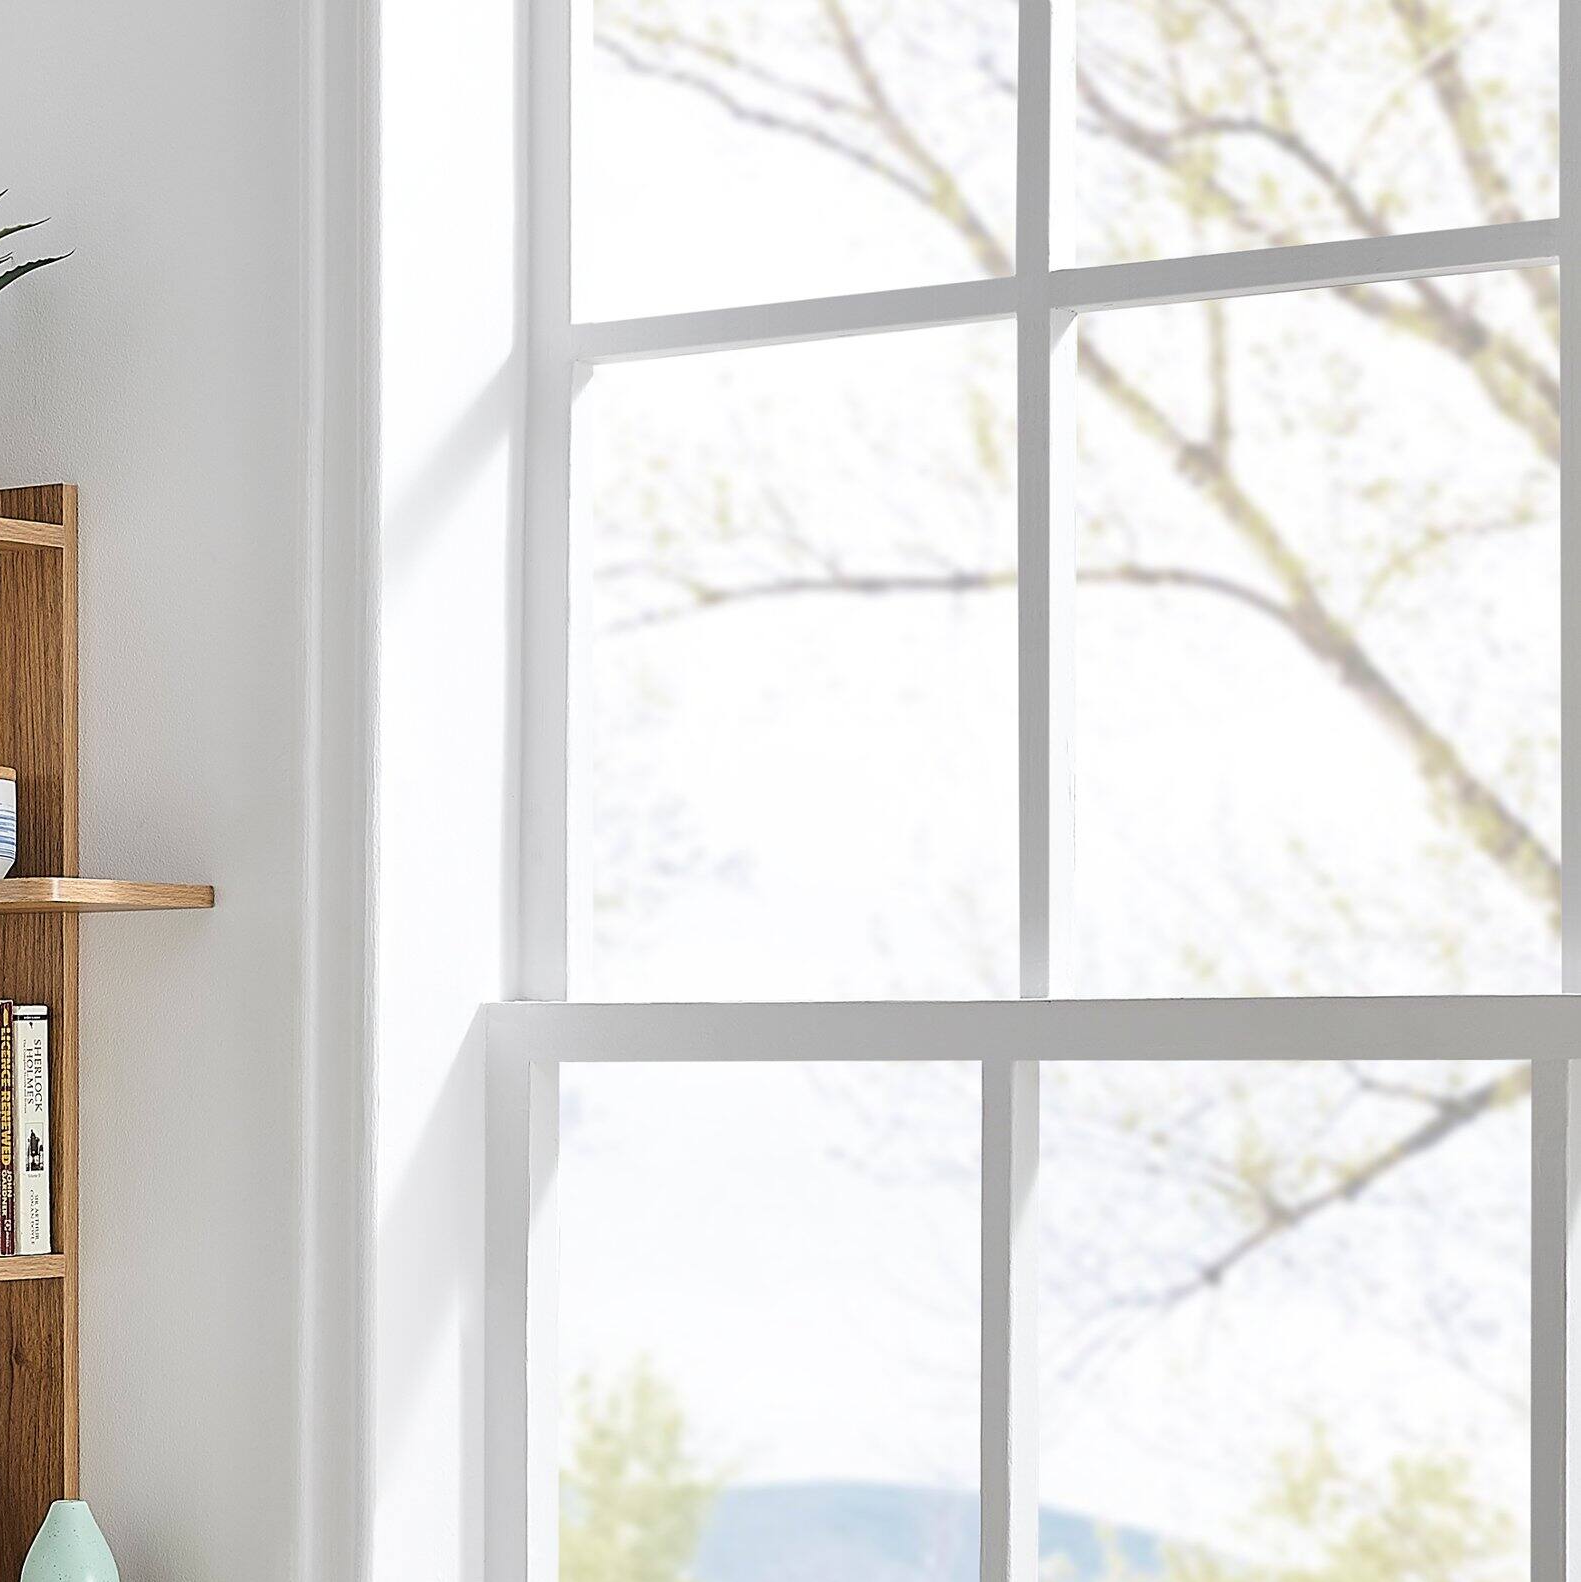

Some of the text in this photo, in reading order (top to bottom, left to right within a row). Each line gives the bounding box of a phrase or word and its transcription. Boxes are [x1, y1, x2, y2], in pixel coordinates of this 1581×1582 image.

[1, 1027, 11, 1166] LICENCE RENEWED
[34, 1038, 43, 1113] SHERLOCK
